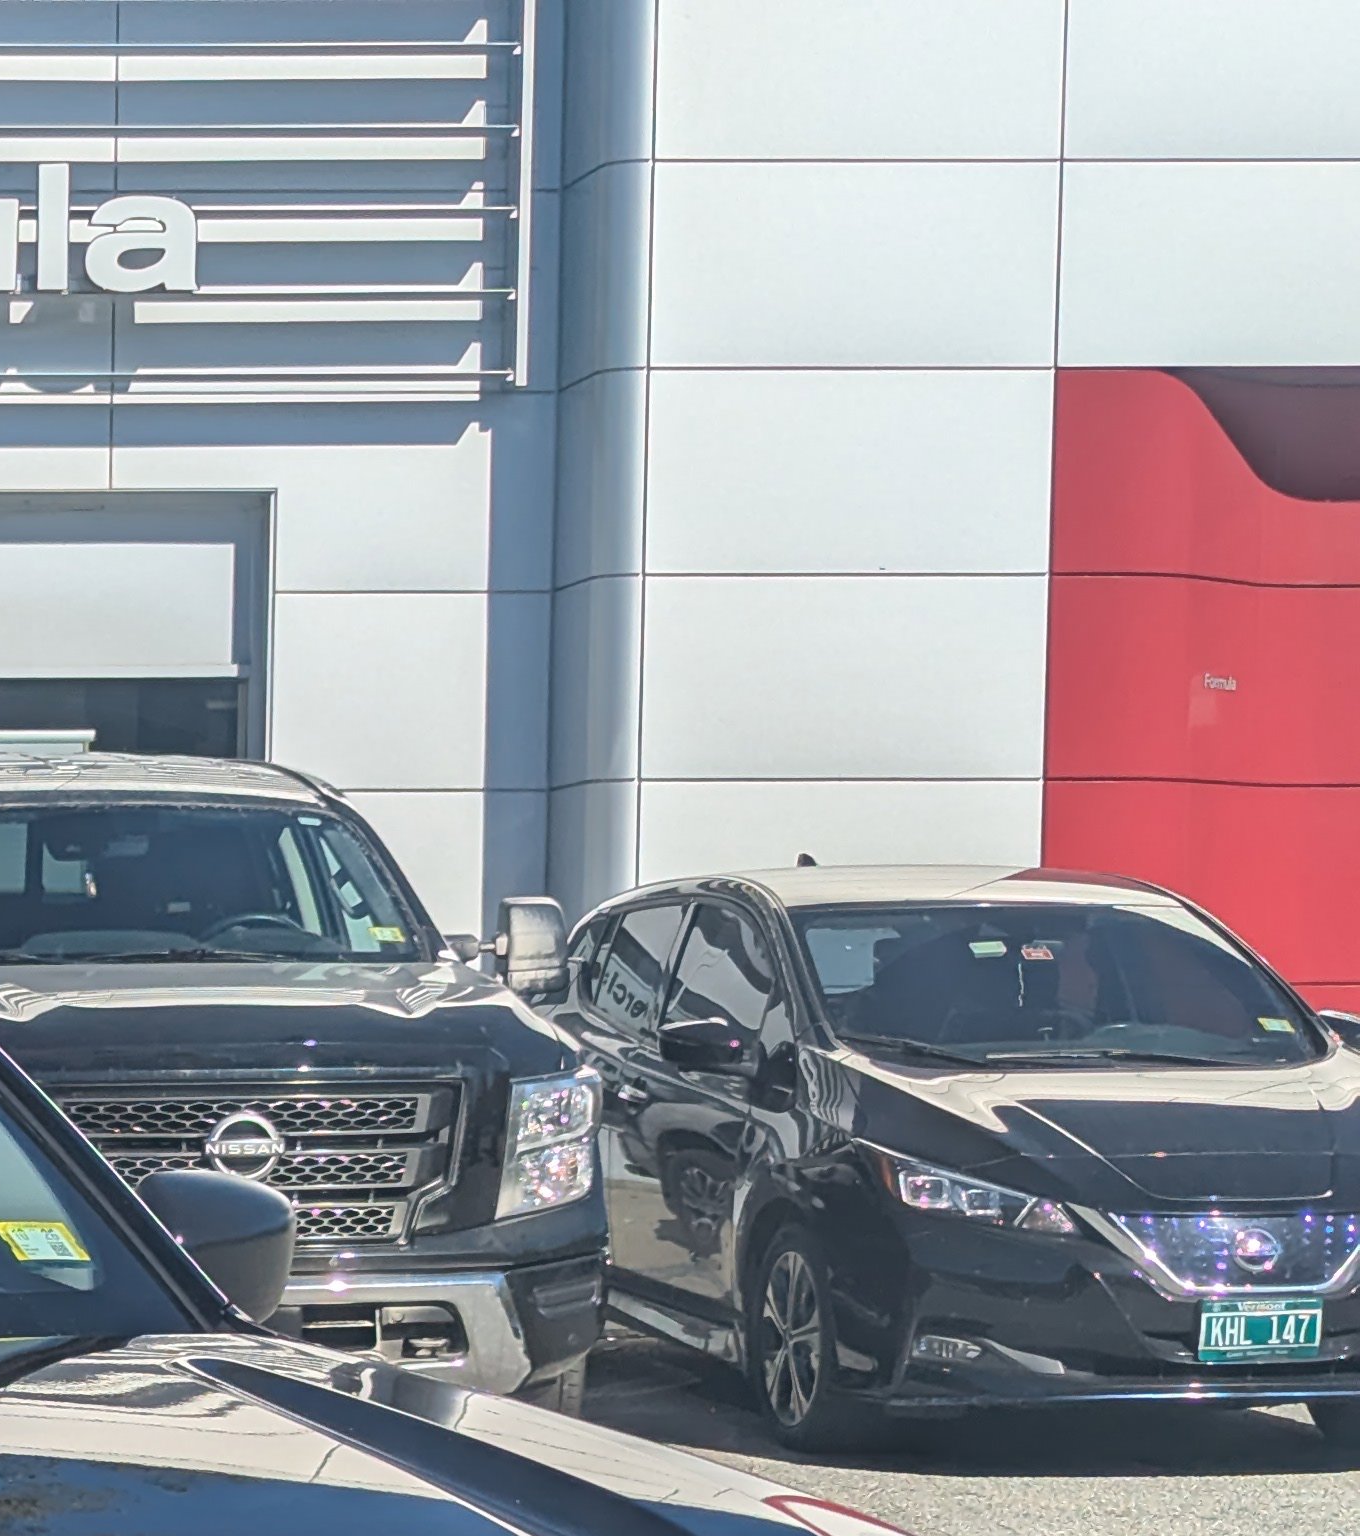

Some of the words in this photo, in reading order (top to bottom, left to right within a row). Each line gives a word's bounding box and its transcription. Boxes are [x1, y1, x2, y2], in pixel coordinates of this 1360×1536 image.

[204, 1143, 284, 1156] NISSAN
[1210, 1316, 1253, 1347] KHL
[1267, 1314, 1311, 1344] 147
